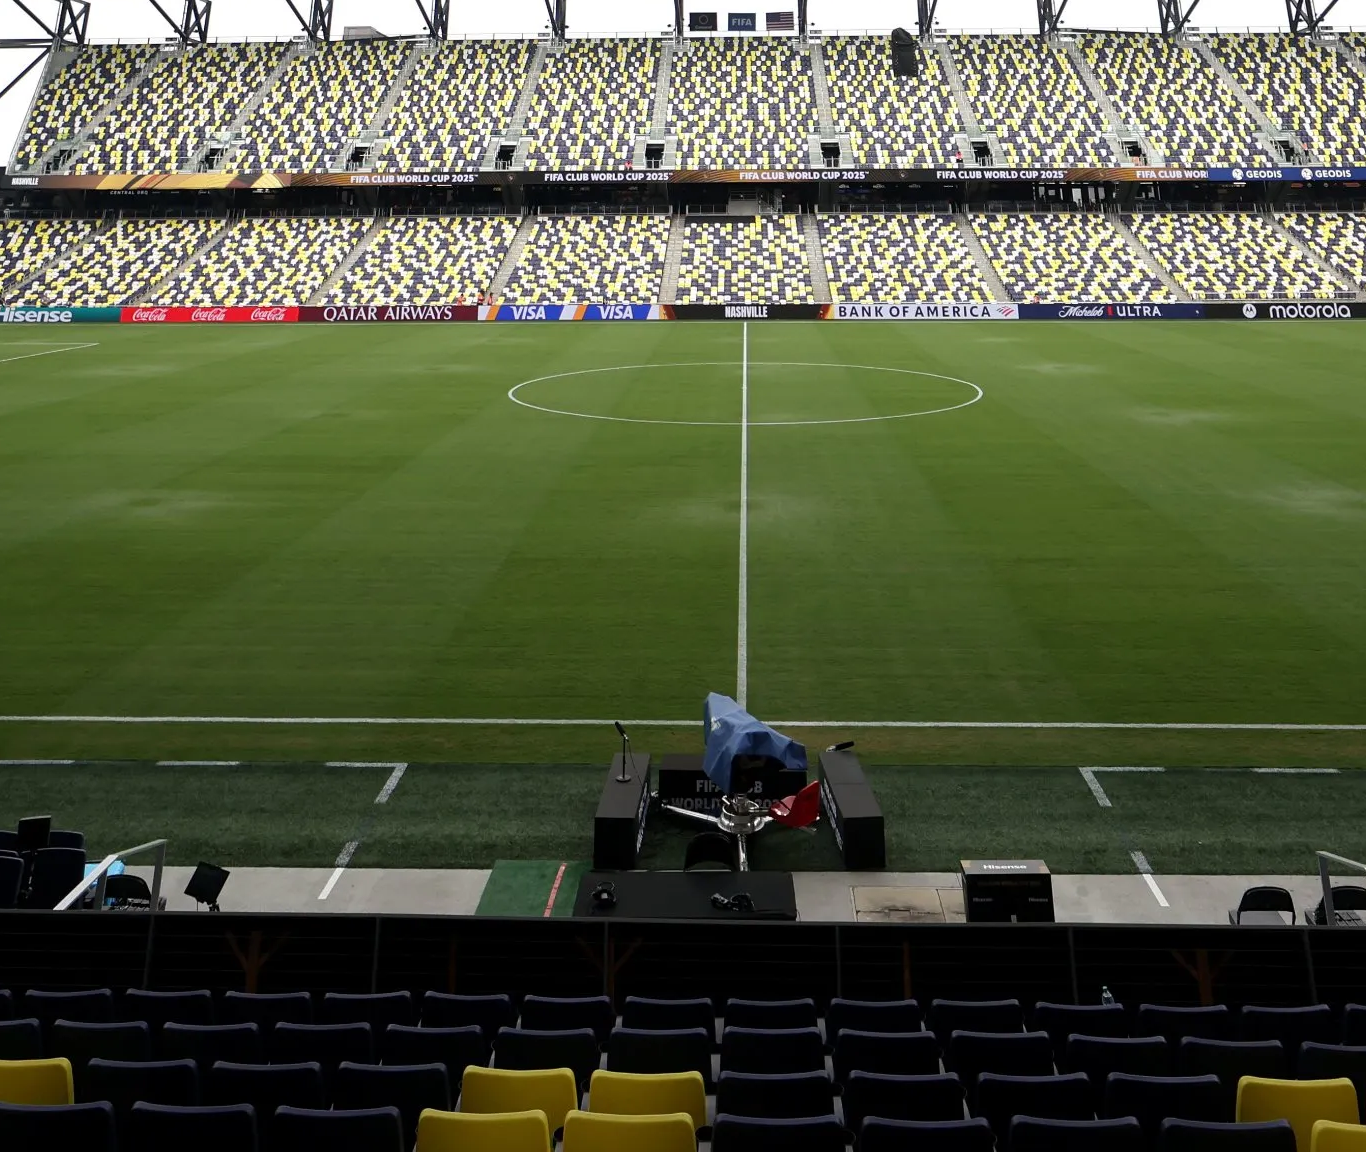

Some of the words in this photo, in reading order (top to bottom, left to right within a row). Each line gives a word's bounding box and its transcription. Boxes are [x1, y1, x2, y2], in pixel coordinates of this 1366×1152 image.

[731, 18, 752, 27] FIFA
[350, 175, 370, 184] FIFA
[371, 175, 395, 184] CLUB
[397, 174, 430, 183] WORLD
[431, 174, 449, 183] CUP
[544, 173, 564, 181] FIFA
[565, 173, 589, 181] CLUB
[590, 172, 624, 181] WORLD
[625, 172, 644, 181] CUP
[739, 172, 759, 180] FIFA
[760, 172, 784, 180] CLUB
[785, 171, 820, 180] WORLD
[821, 171, 840, 180] CUP
[936, 171, 957, 179] FIFA
[958, 171, 982, 179] CLUB
[983, 170, 1018, 179] WORLD
[1019, 170, 1039, 179] CUP
[1136, 170, 1157, 179] FIFA
[1158, 170, 1182, 179] CLUB
[1246, 170, 1282, 179] GEODIS
[1315, 169, 1351, 178] GEODIS
[11, 177, 39, 185] NASHVILLE
[132, 307, 168, 322] Coca-Cola
[191, 307, 225, 322] Coca-Cola
[250, 307, 286, 322] Coca-Cola
[323, 306, 378, 322] QATAR
[384, 306, 452, 321] AIRWAYS
[510, 306, 546, 320] VISA
[596, 306, 633, 320] VISA
[724, 306, 768, 318] NASHVILLE
[838, 306, 884, 318] BANK
[889, 306, 909, 318] OF
[915, 305, 991, 318] AMERICA
[1058, 305, 1104, 318] Michelob
[1116, 306, 1162, 317] ULTRA
[1269, 302, 1351, 319] motorola
